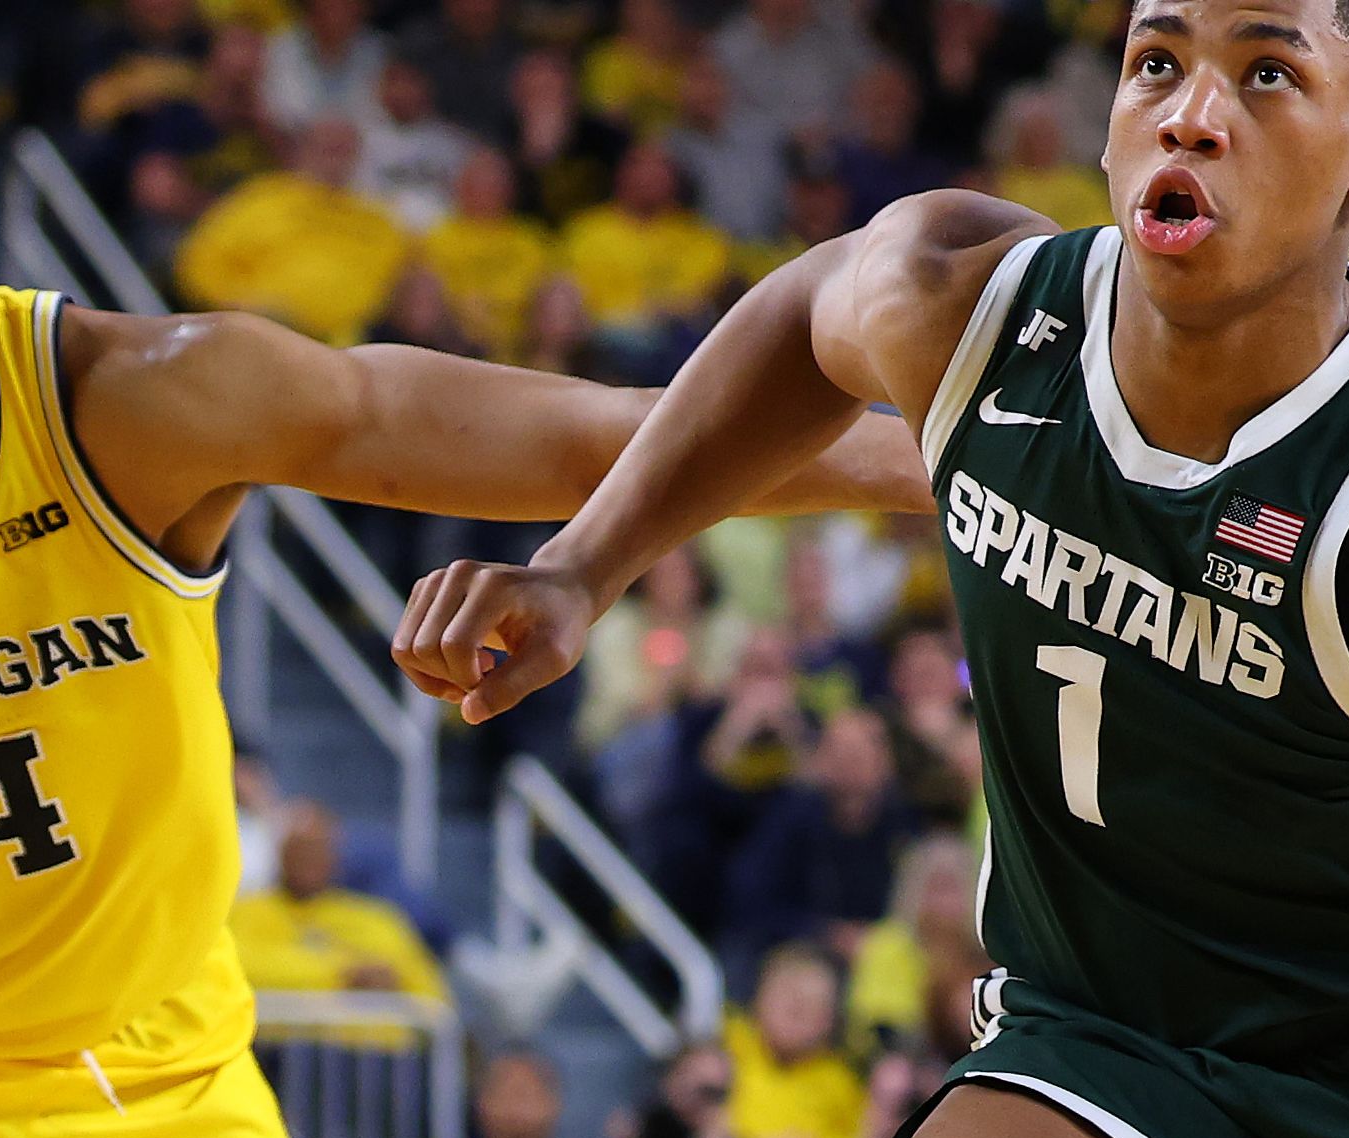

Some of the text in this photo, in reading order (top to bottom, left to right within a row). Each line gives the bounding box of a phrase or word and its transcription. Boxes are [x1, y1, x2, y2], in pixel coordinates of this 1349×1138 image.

[1017, 308, 1068, 352] JF
[947, 469, 1286, 700] SPARTANS
[1036, 644, 1107, 828] 1
